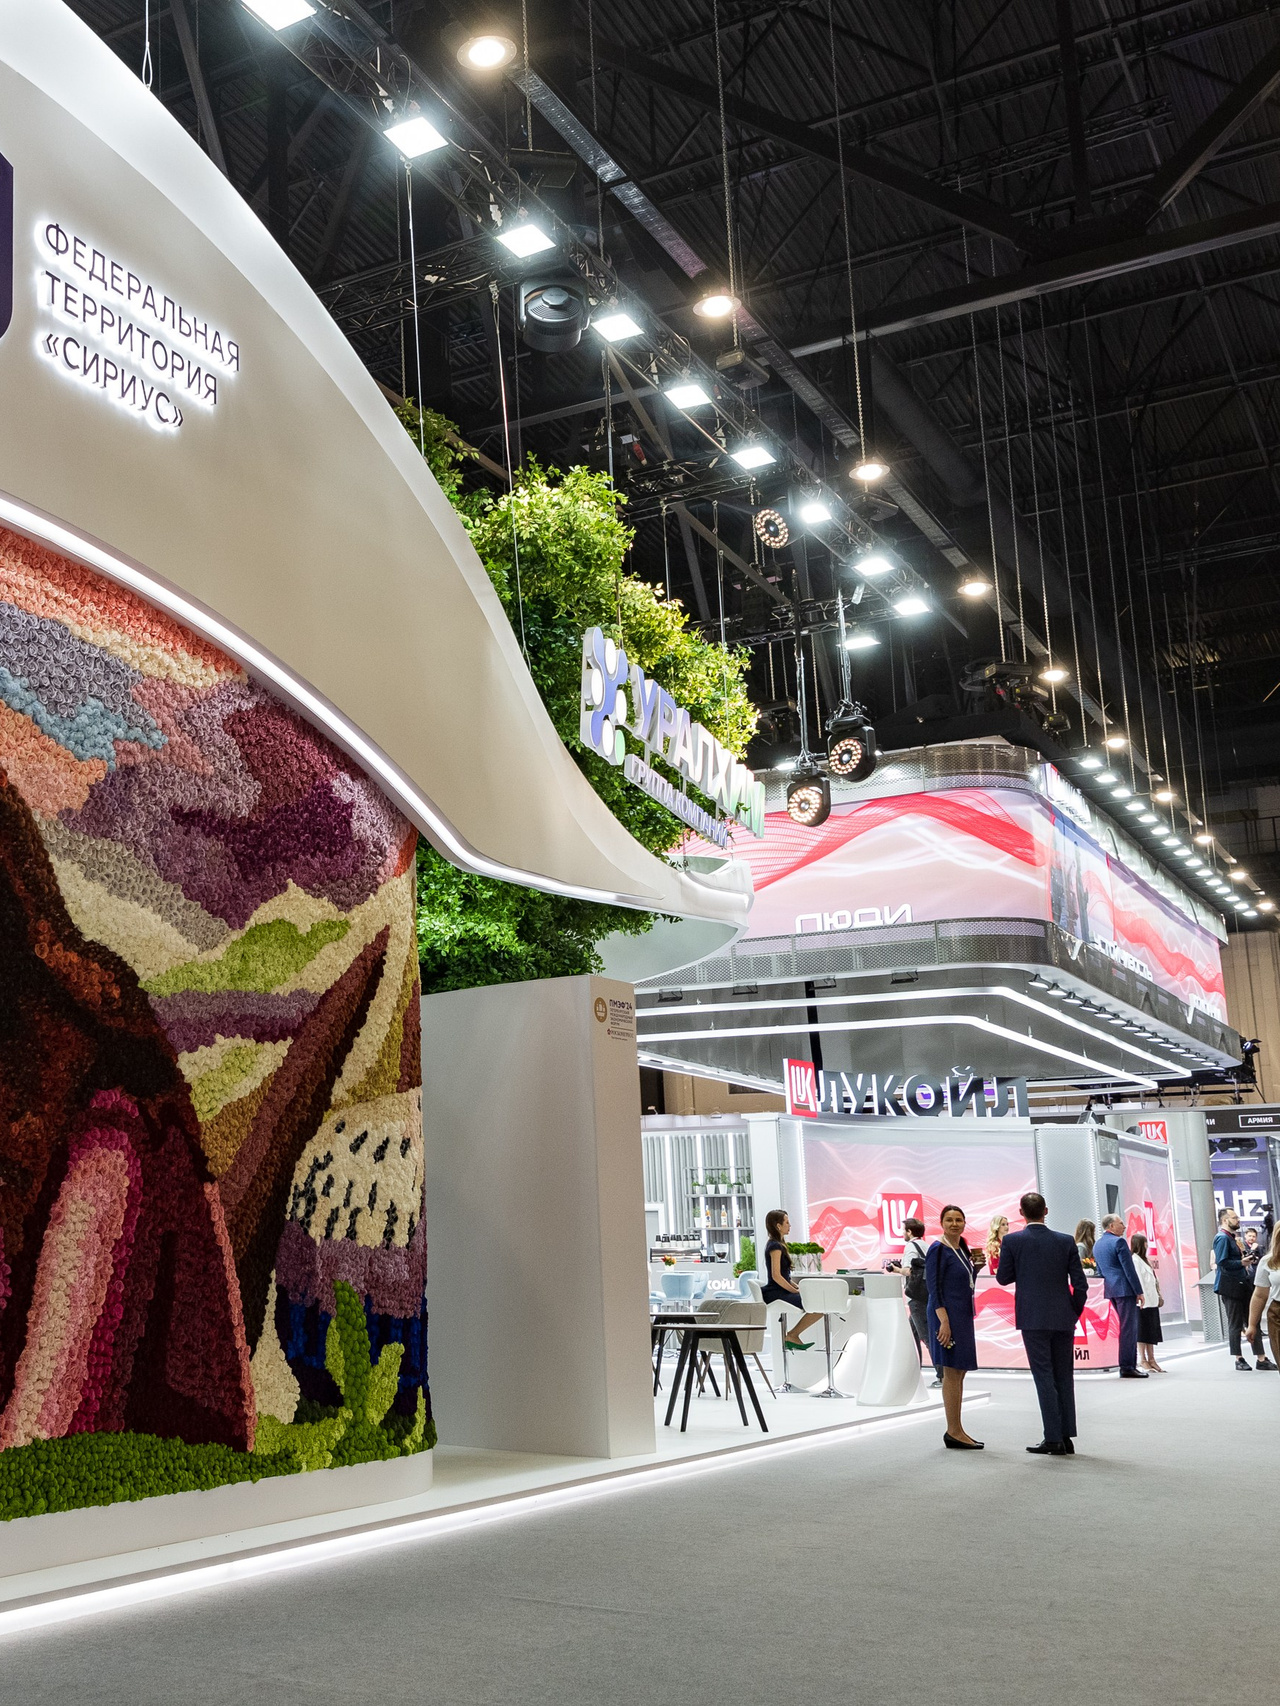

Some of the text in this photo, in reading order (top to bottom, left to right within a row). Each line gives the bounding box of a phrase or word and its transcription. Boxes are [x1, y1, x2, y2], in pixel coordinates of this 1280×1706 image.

[45, 222, 240, 372] ФЕДЕРАЛЬНАЯ
[45, 270, 217, 405] ТЕРРИТОРИЯ
[45, 333, 184, 427] «СИРИУС»
[629, 663, 766, 839] УРАЛХИМ
[817, 1065, 1030, 1118] ЛУКОЙЛ
[1247, 1116, 1274, 1124] АРМИЯ
